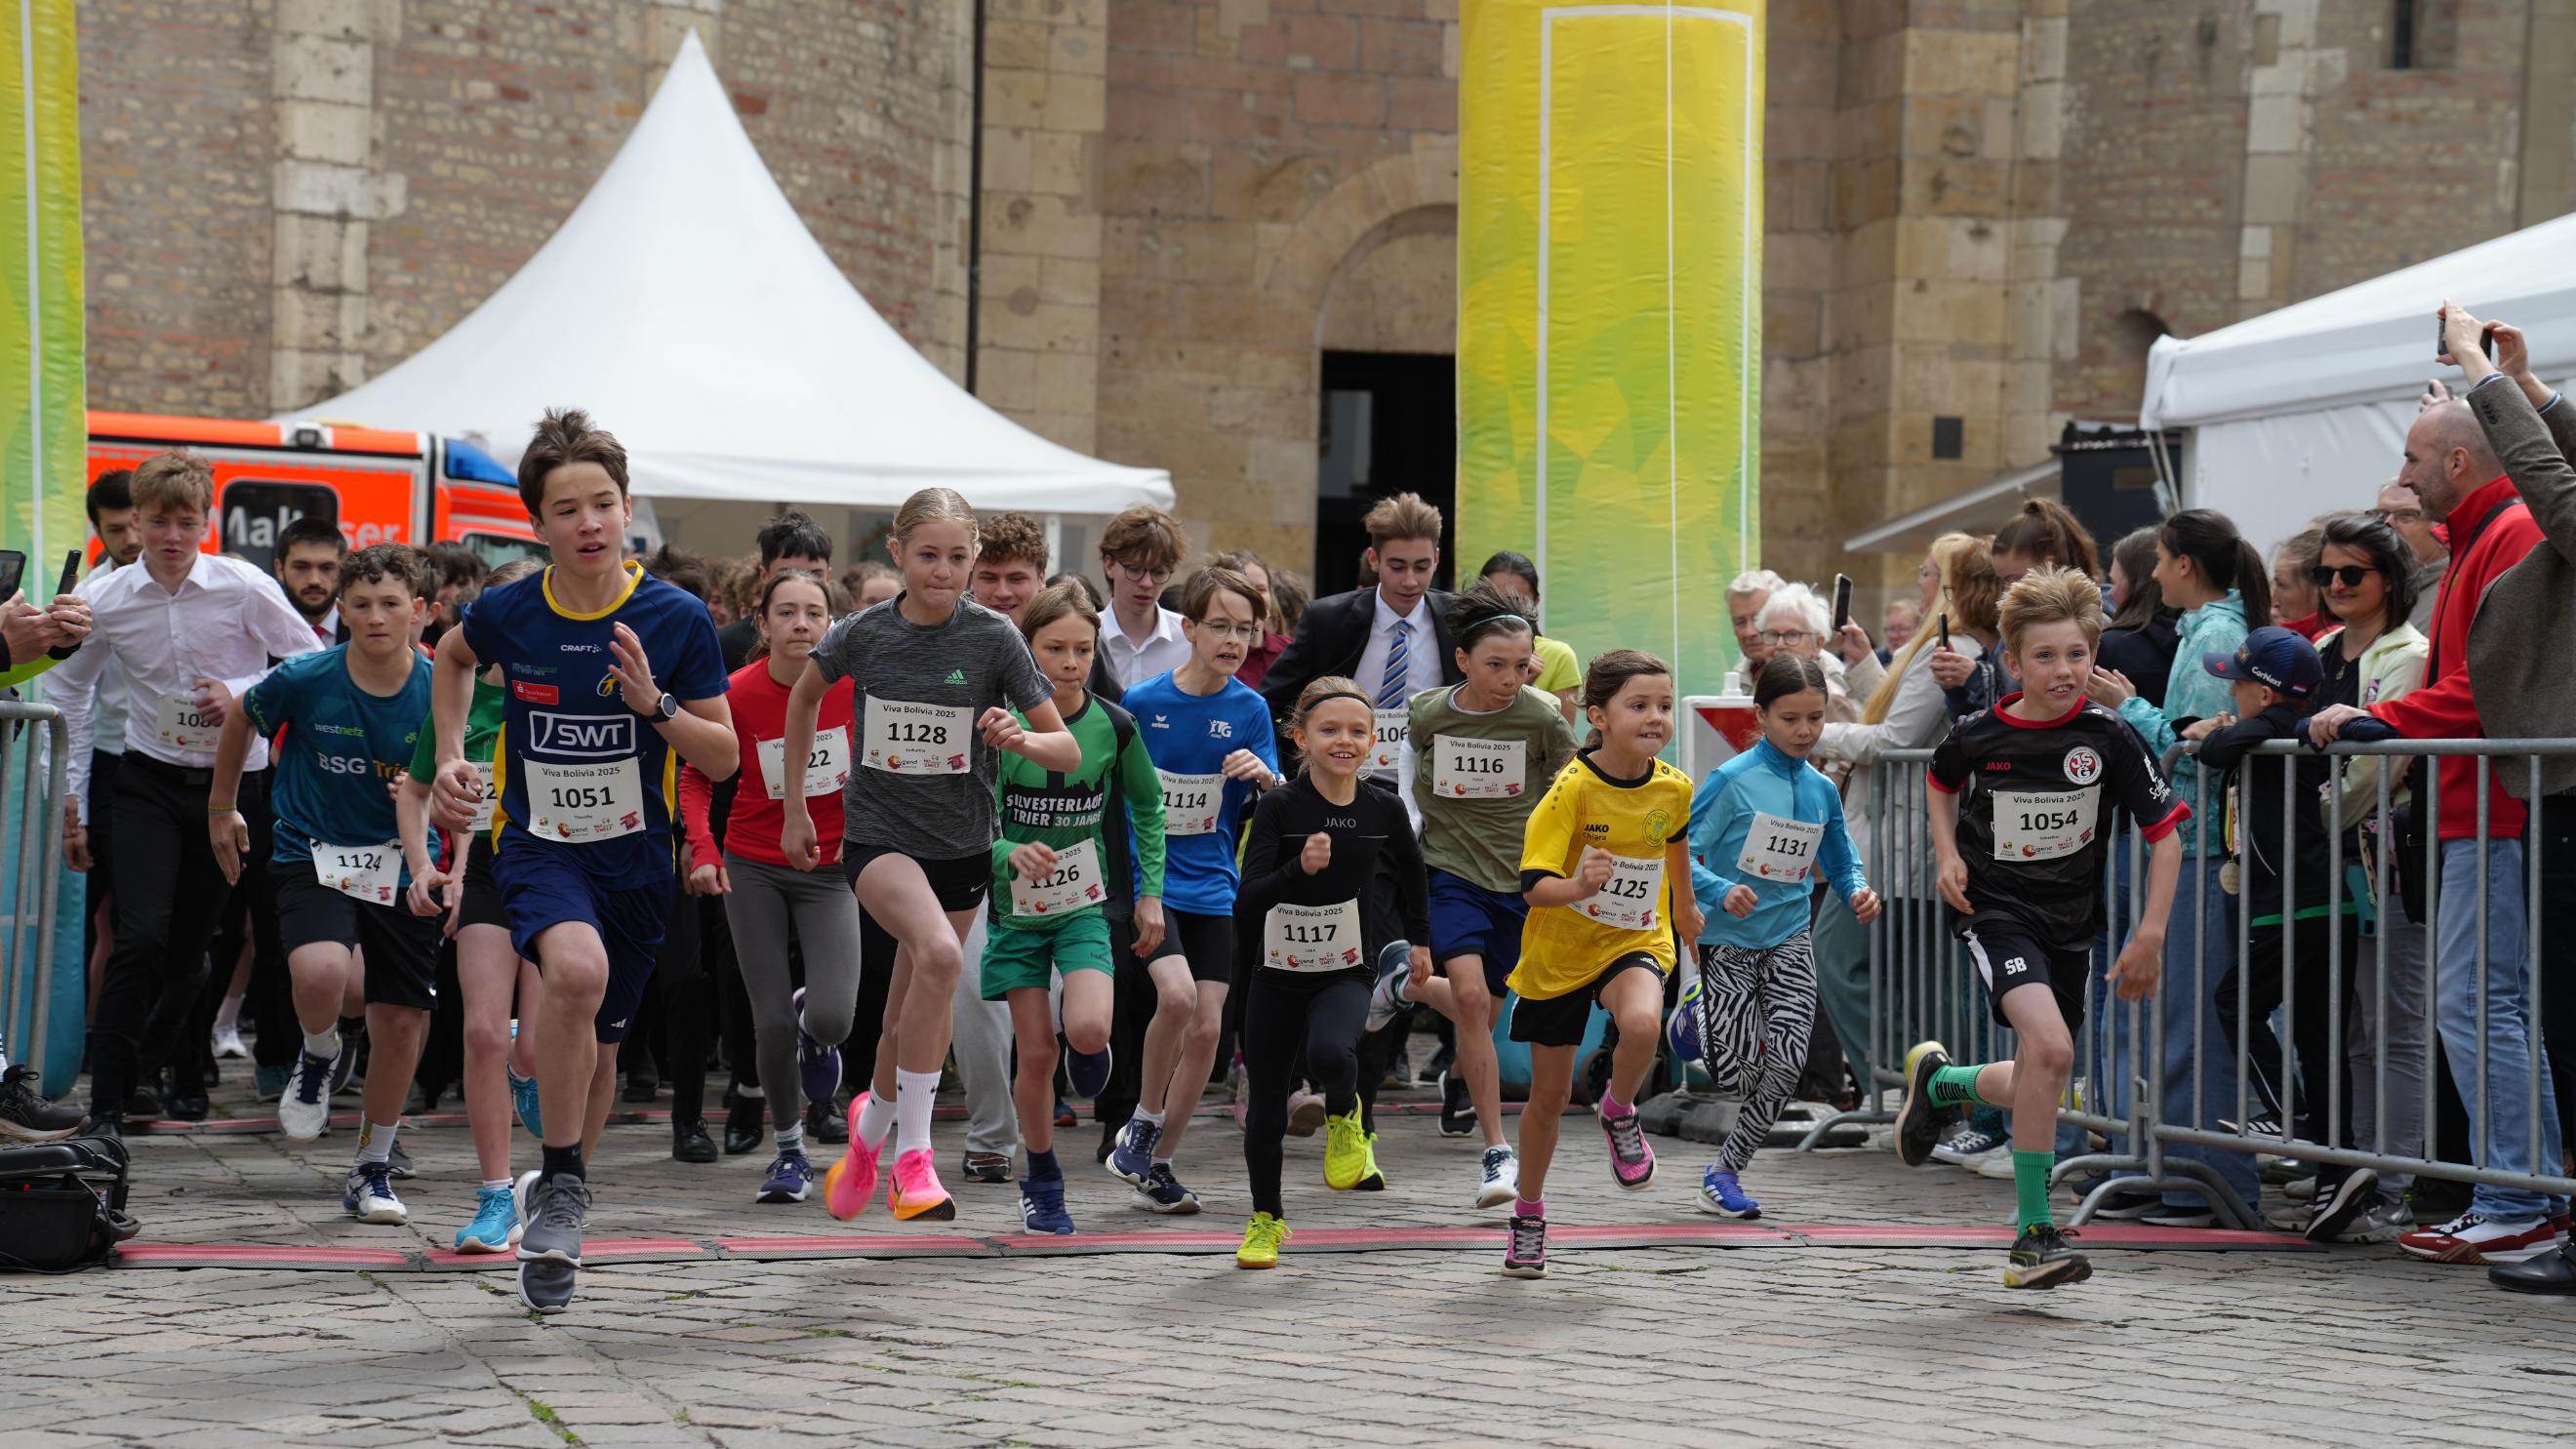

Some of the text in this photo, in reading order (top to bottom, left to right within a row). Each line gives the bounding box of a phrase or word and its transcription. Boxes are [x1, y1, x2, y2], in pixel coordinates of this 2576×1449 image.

[560, 644, 592, 653] CRAFT
[2251, 665, 2282, 688] CarNext
[177, 711, 212, 728] 108
[883, 704, 956, 718] Viva Bolivia 2025
[314, 722, 365, 738] westnetz
[557, 723, 624, 747] SWT
[816, 732, 833, 743] 2025
[887, 722, 947, 745] 1128
[1377, 726, 1408, 743] 106
[1450, 740, 1466, 748] Viva
[1467, 742, 1492, 750] Bolivia
[317, 750, 367, 775] BSG
[808, 749, 831, 769] 22
[1454, 755, 1505, 774] 1116
[1985, 761, 2012, 771] JAKO
[542, 766, 621, 778] Viva Bolivia 2025
[1161, 774, 1177, 784] Viva
[551, 785, 616, 809] 1051
[1006, 792, 1104, 812] SILVESTERLAUF
[1163, 790, 1207, 809] 1114
[2034, 795, 2065, 805] Bolivia
[2067, 791, 2085, 803] 2025
[1014, 808, 1102, 827] TRIER 30 JAHRE
[1323, 818, 1356, 827] JAKO
[1770, 819, 1784, 828] Viva
[1785, 823, 1805, 832] Bolivia
[2020, 809, 2078, 831] 1054
[1583, 832, 1607, 841] Chiara
[1584, 824, 1610, 833] JAKO
[1065, 846, 1082, 859] 2025
[1766, 835, 1808, 857] 1131
[336, 852, 382, 872] 1124
[1619, 861, 1644, 871] Bolivia
[1644, 863, 1659, 871] 2025
[1276, 906, 1344, 917] Viva Bolivia 2025
[1283, 923, 1338, 944] 1117
[2004, 956, 2028, 976] SB
